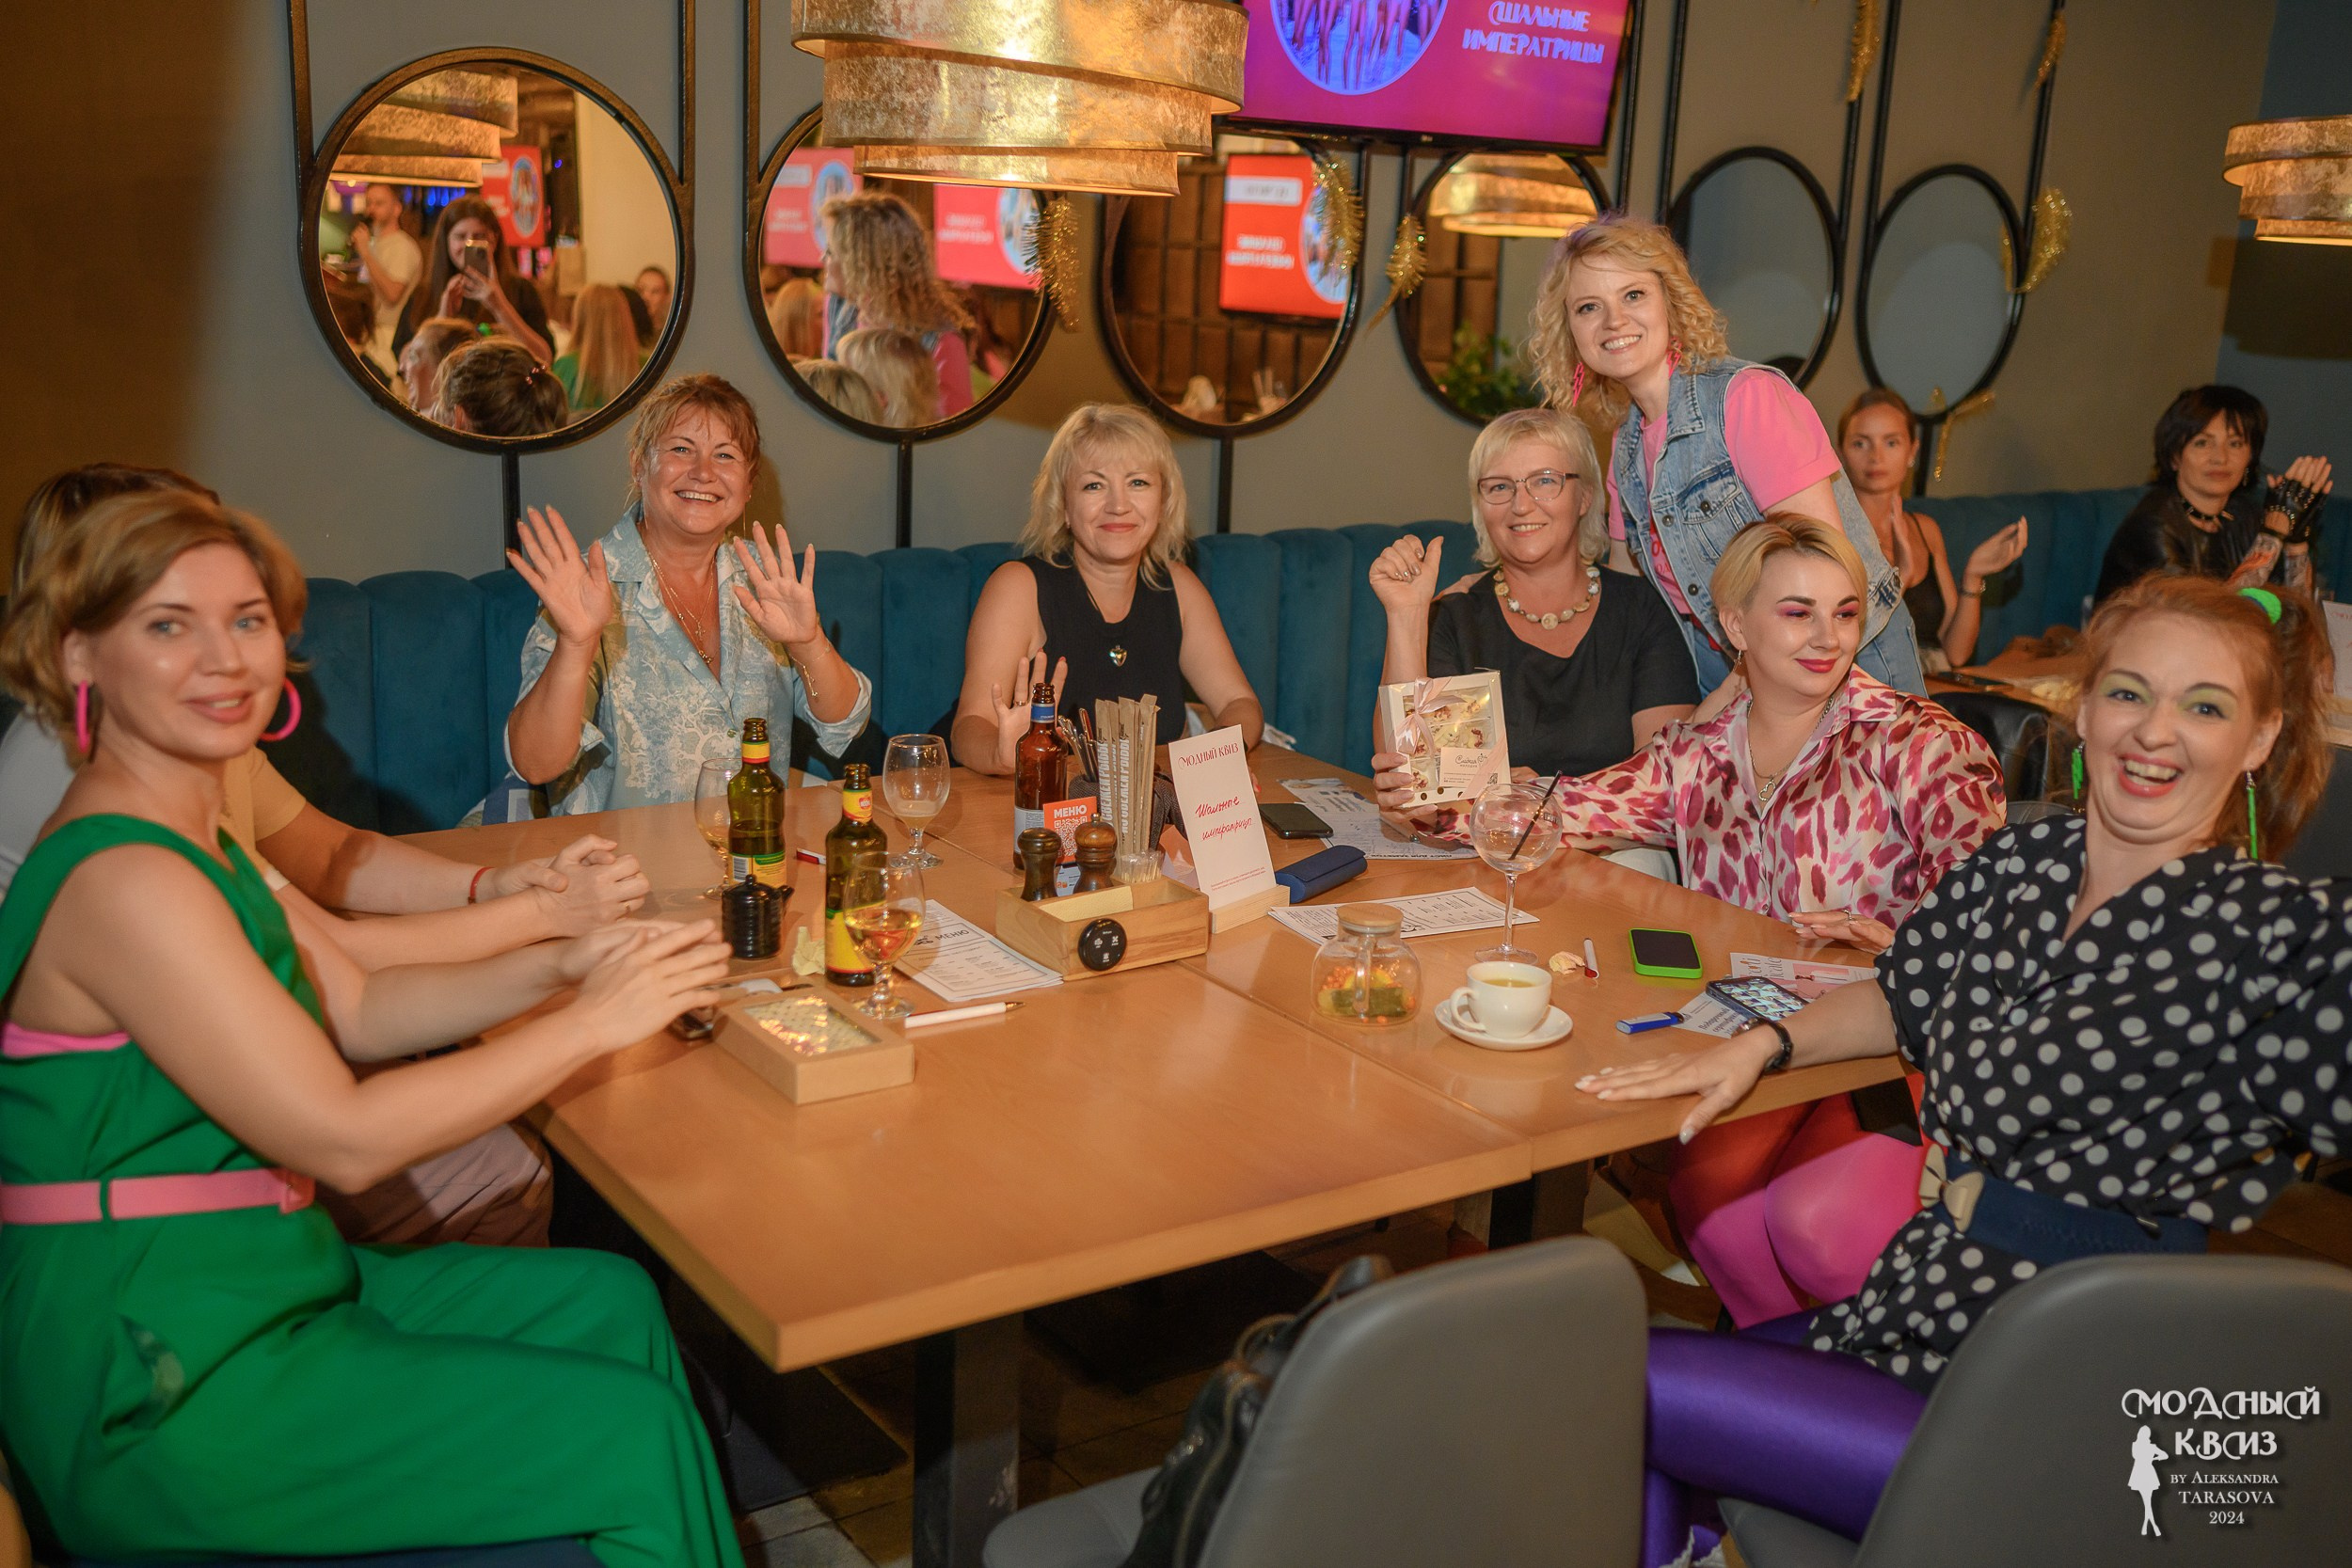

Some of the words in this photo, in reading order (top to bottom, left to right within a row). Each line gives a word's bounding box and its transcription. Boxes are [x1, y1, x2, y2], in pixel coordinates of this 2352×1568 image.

[1462, 28, 1605, 63] ИМПЕРАТРИЦЫ
[1178, 748, 1217, 769] МОДНЫЙ
[1218, 742, 1239, 756] КВИЗ
[1054, 804, 1088, 818] МЕНЮ
[935, 929, 969, 941] МЕНЮ
